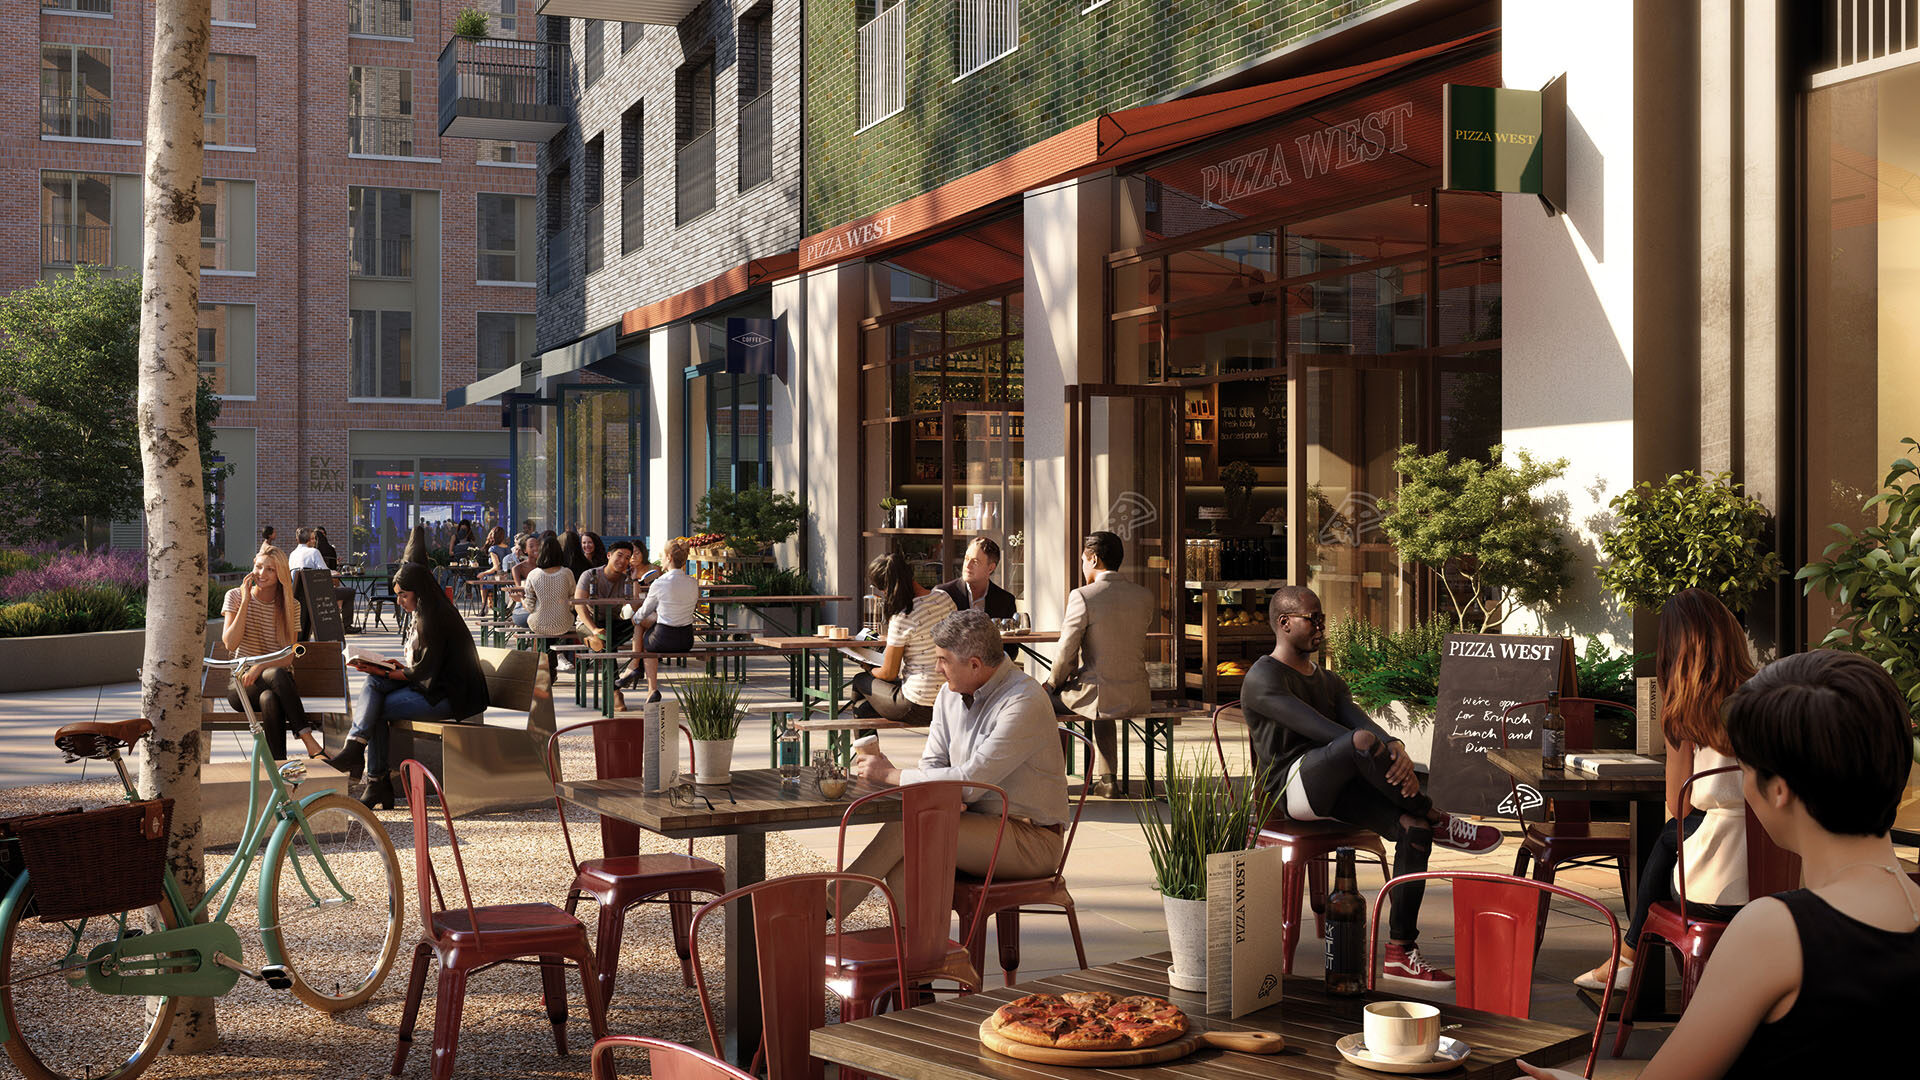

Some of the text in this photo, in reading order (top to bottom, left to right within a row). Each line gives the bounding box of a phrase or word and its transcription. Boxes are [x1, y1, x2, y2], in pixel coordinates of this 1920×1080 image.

[1455, 129, 1535, 145] PIZZA WEST
[1201, 101, 1413, 209] PIZZA WEST
[807, 215, 896, 262] PIZZA WEST
[310, 456, 331, 468] EV
[310, 481, 344, 492] MAN
[423, 479, 479, 493] ENTRANCE
[1449, 641, 1554, 660] PIZZA WEST
[1483, 710, 1531, 725] Brunch
[1452, 725, 1534, 740] Lunch and
[1236, 860, 1246, 903] WEST
[1236, 904, 1246, 945] PIZZA
